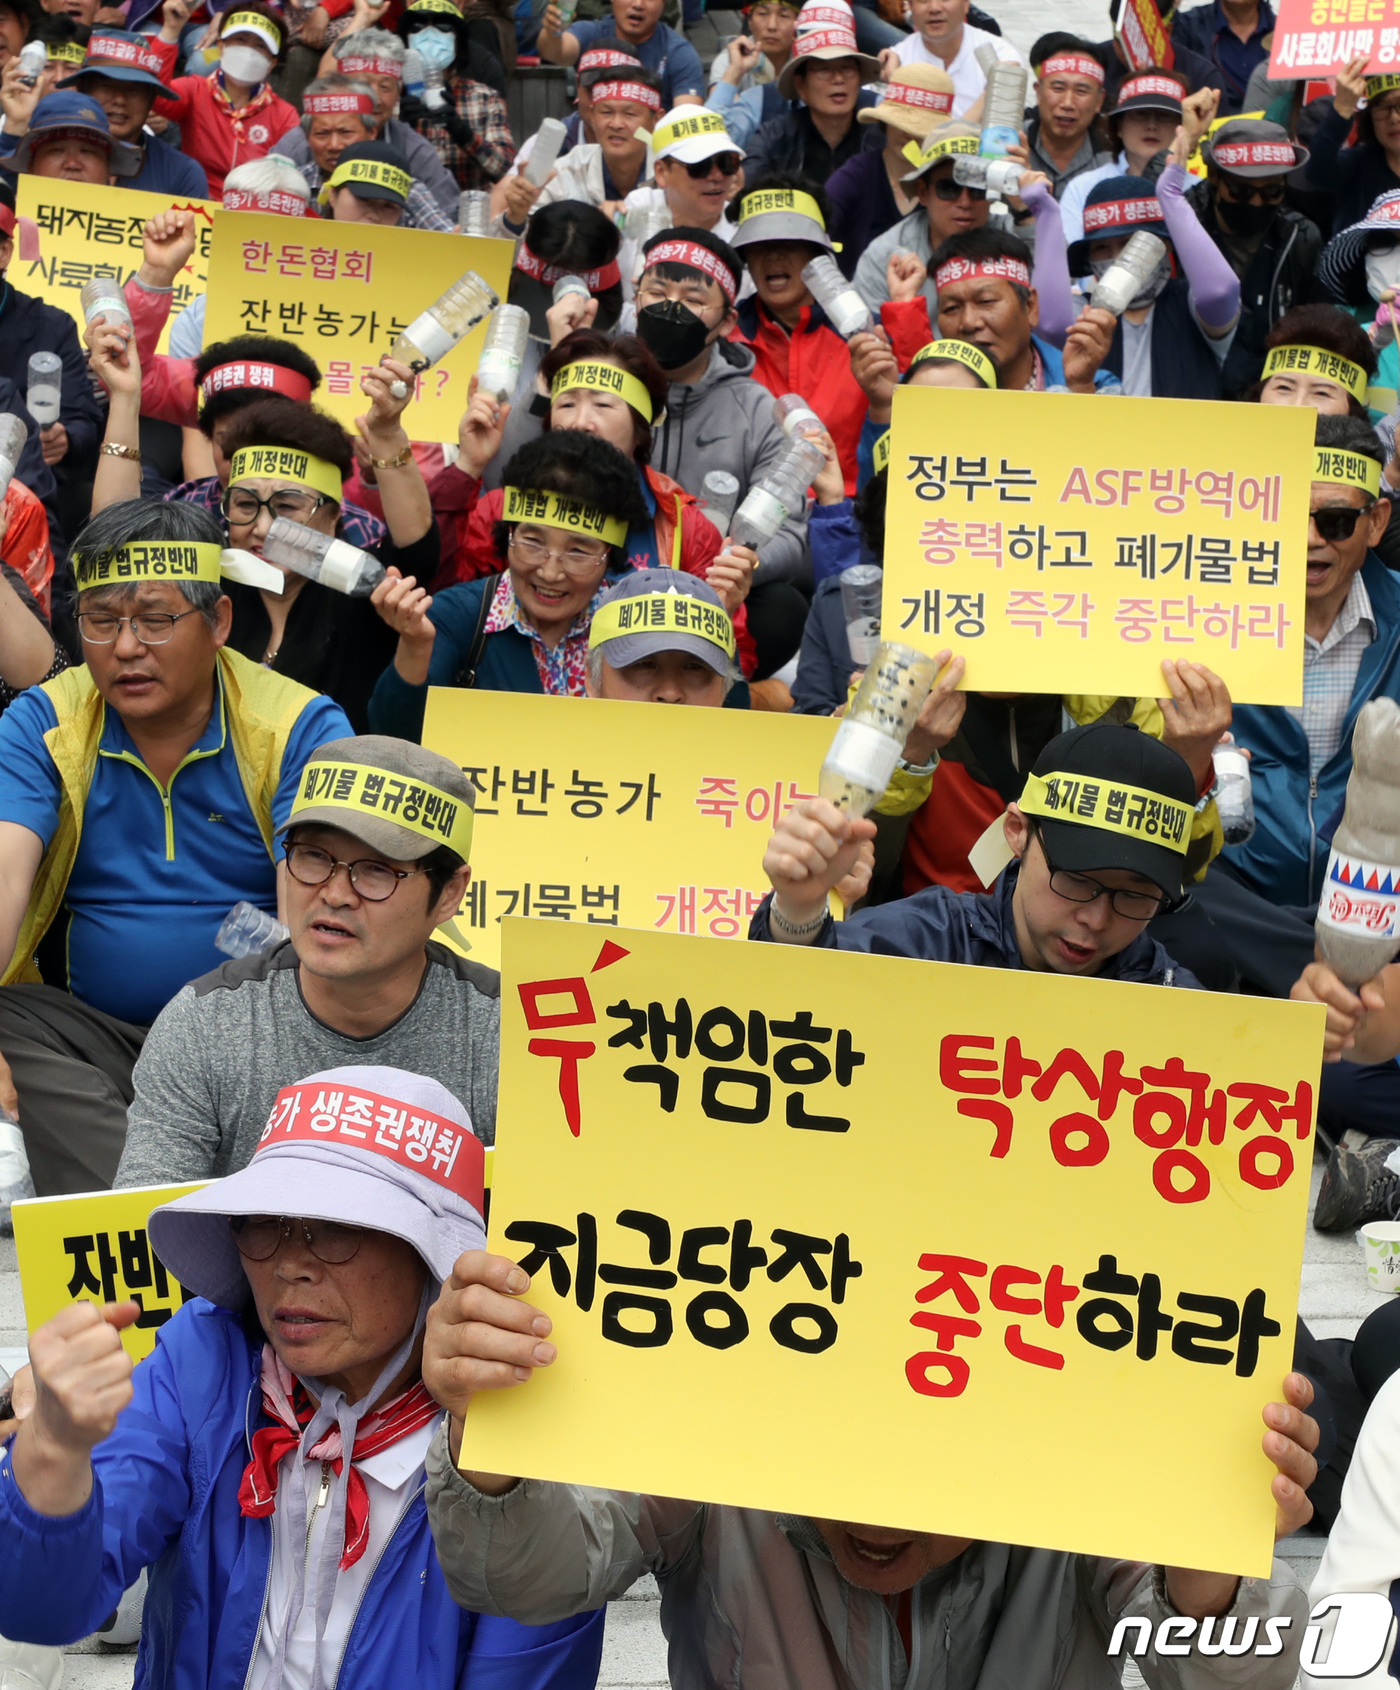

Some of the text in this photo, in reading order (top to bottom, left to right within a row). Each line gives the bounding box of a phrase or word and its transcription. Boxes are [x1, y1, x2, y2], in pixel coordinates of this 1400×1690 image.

[241, 240, 373, 283] 한돈협회
[213, 365, 245, 391] 생존권
[249, 365, 274, 387] 쟁취
[572, 366, 624, 392] 개정반대
[934, 342, 984, 371] 개정반대
[1269, 349, 1360, 389] 폐기물법 개정반대
[250, 451, 308, 479] 개정반대
[906, 455, 1281, 523] 정부는 ASF방역에
[1316, 452, 1367, 483] 개정반대
[115, 547, 197, 577] 법규정반대
[919, 518, 1279, 586] 총력하고 폐기물법
[618, 599, 730, 647] 폐기물 법규정반대
[900, 590, 1291, 649] 개정 즉각 중단하라
[304, 768, 458, 838] 폐기물 법규정반대
[461, 765, 661, 822] 잔반농가
[1044, 779, 1187, 844] 폐기물 법규정반대
[517, 976, 1313, 1203] 무책임한 탁상행정
[309, 1091, 463, 1179] 생존권쟁취
[504, 1210, 1282, 1398] 지금당장 중단하라
